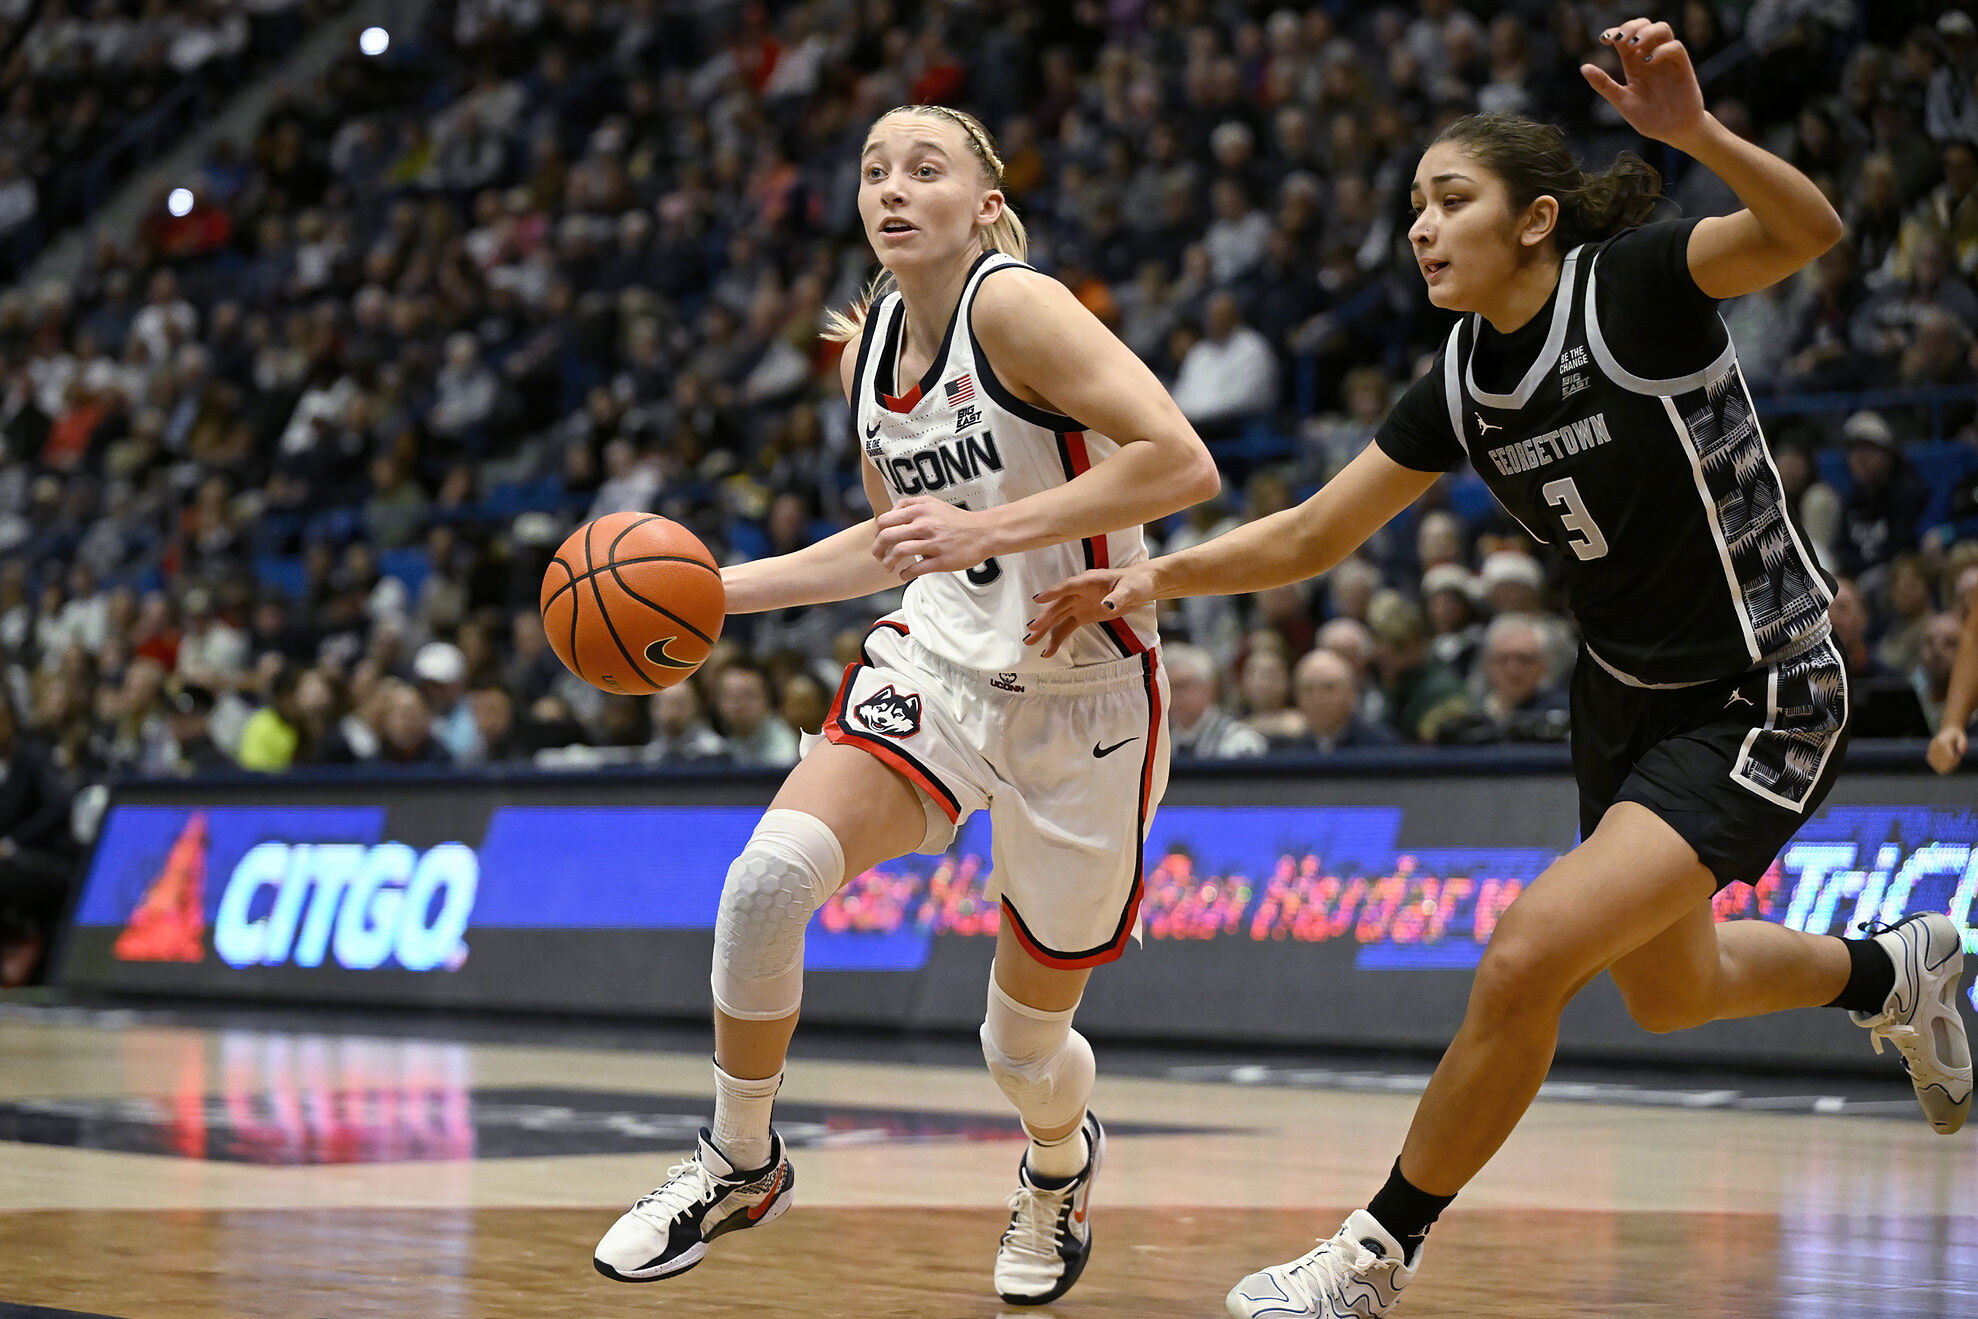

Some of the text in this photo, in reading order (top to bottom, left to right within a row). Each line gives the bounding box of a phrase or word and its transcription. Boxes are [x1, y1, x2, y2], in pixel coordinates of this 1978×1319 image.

[1559, 354, 1588, 374] CHANGE
[1560, 345, 1584, 364] BE THE
[1561, 373, 1581, 388] BIG
[1562, 376, 1590, 394] EAST
[956, 411, 983, 429] EAST
[957, 404, 975, 420] BIG
[1488, 413, 1612, 476] GEORGETOWN
[875, 430, 1005, 495] UCONN
[1542, 476, 1609, 561] 3
[990, 678, 1025, 693] UCONN
[213, 840, 480, 972] CITGO
